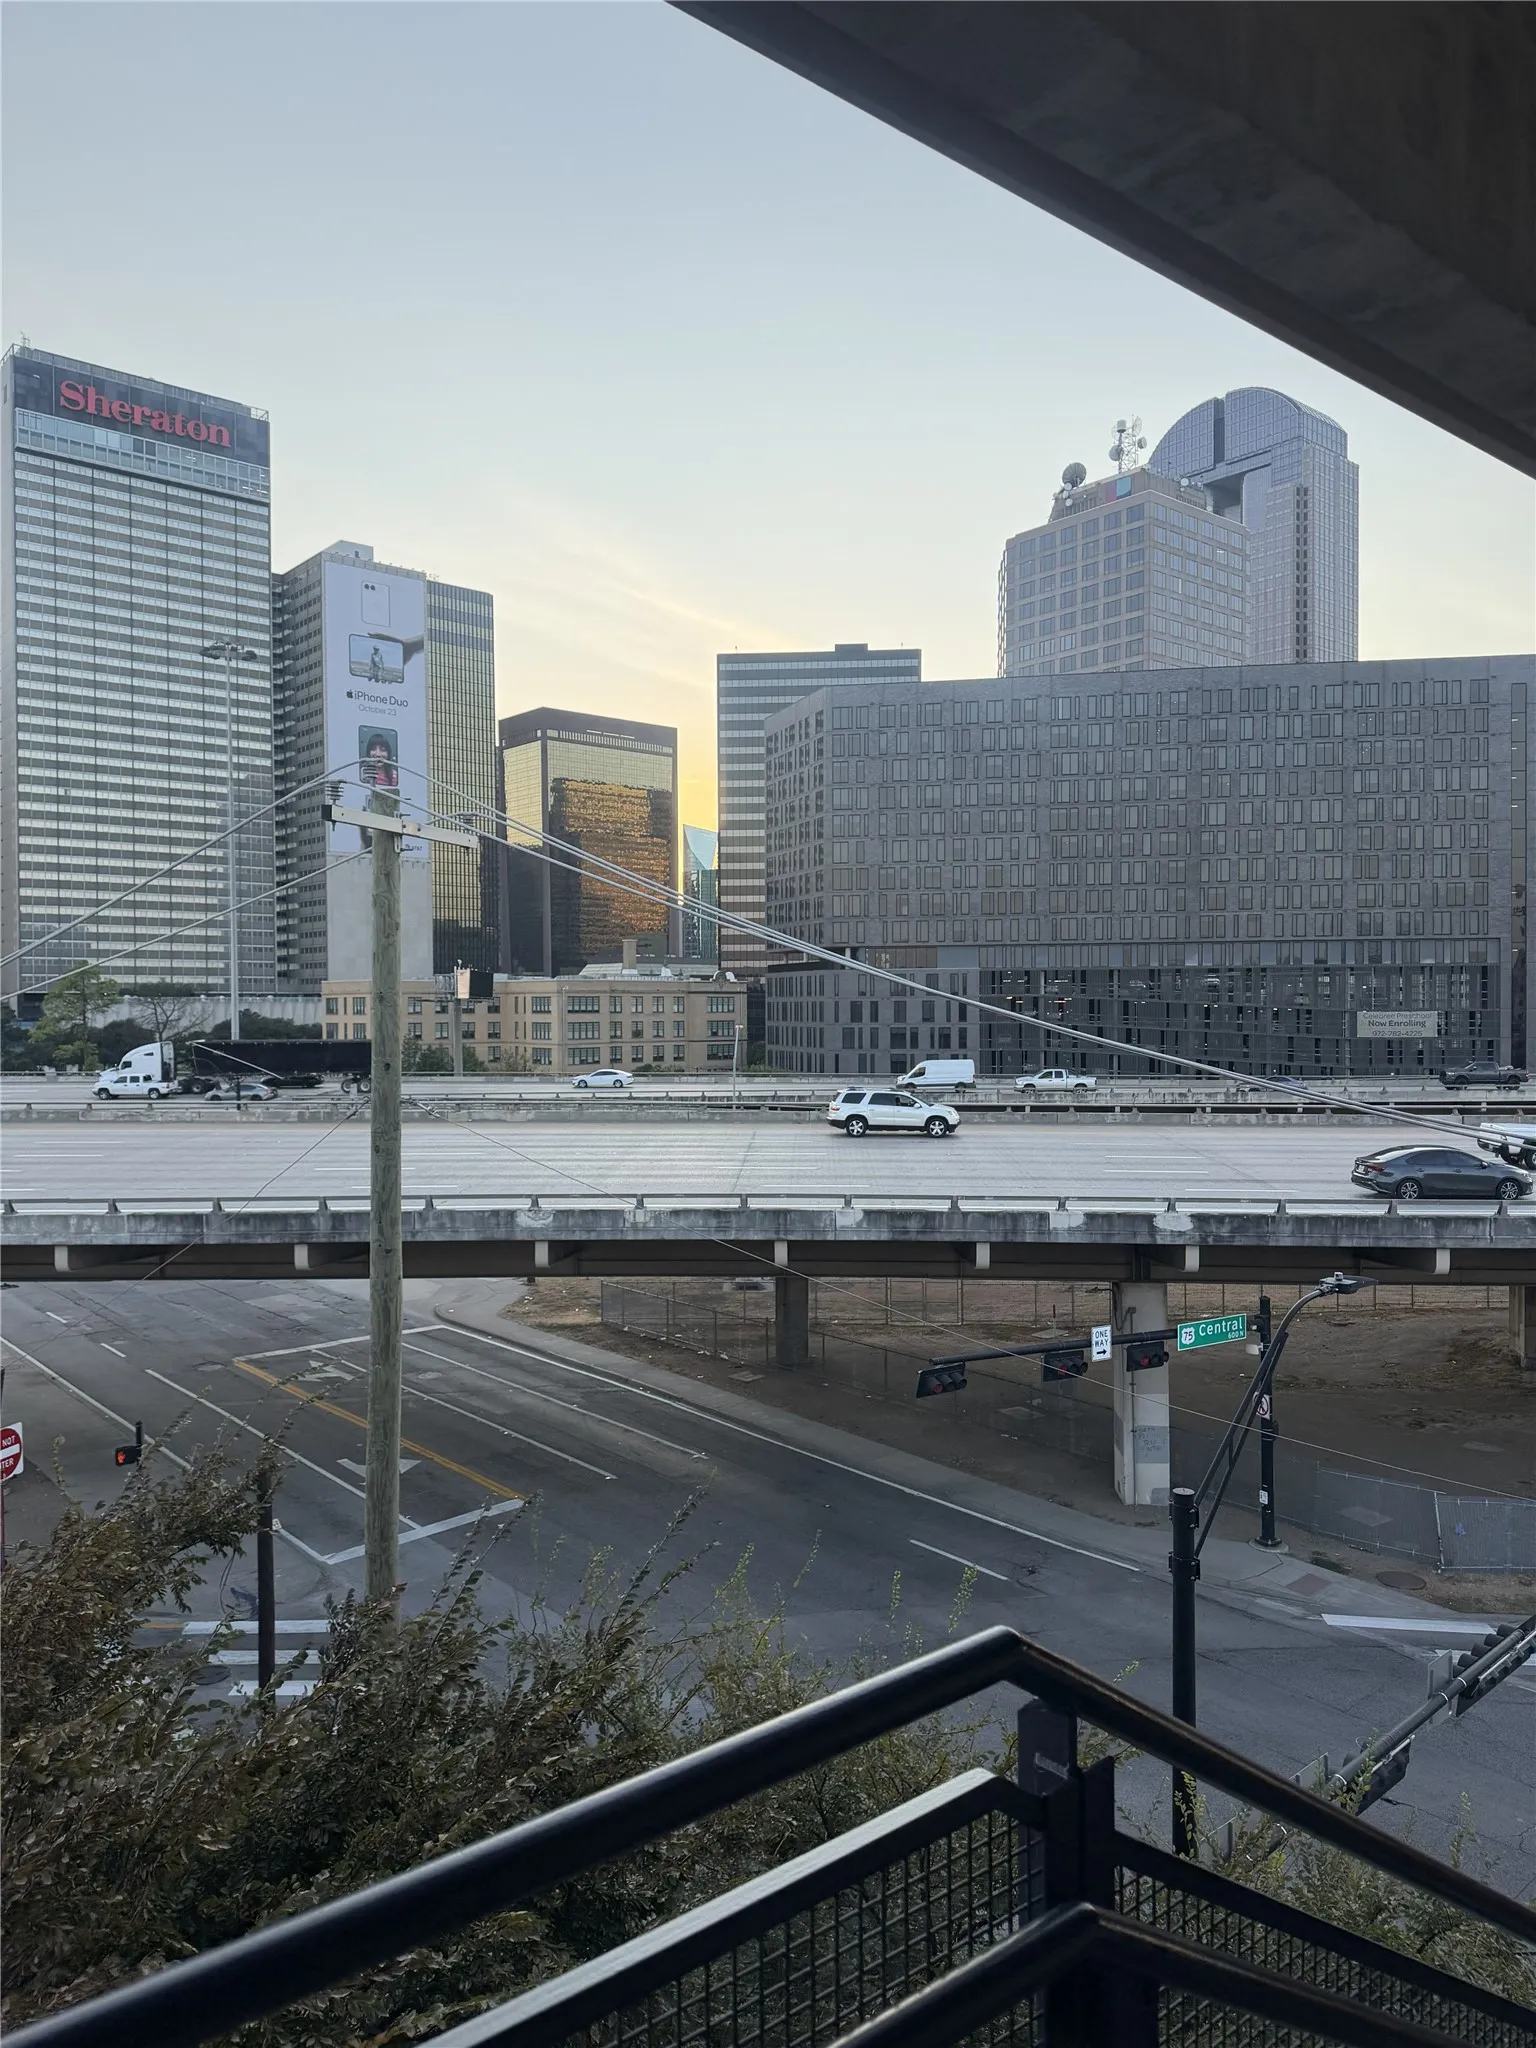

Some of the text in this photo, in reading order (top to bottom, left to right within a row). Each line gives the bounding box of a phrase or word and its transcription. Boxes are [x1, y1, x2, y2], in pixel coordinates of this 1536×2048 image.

[60, 380, 231, 447] Sheraton
[354, 690, 408, 708] iPhone Duo
[358, 703, 397, 716] October 23
[1388, 1020, 1426, 1028] Enrolling
[1094, 1330, 1108, 1339] ONE
[1183, 1316, 1243, 1342] 75 Central
[1239, 1330, 1244, 1338] N
[1094, 1339, 1109, 1348] WAY
[2, 1435, 16, 1447] NOT
